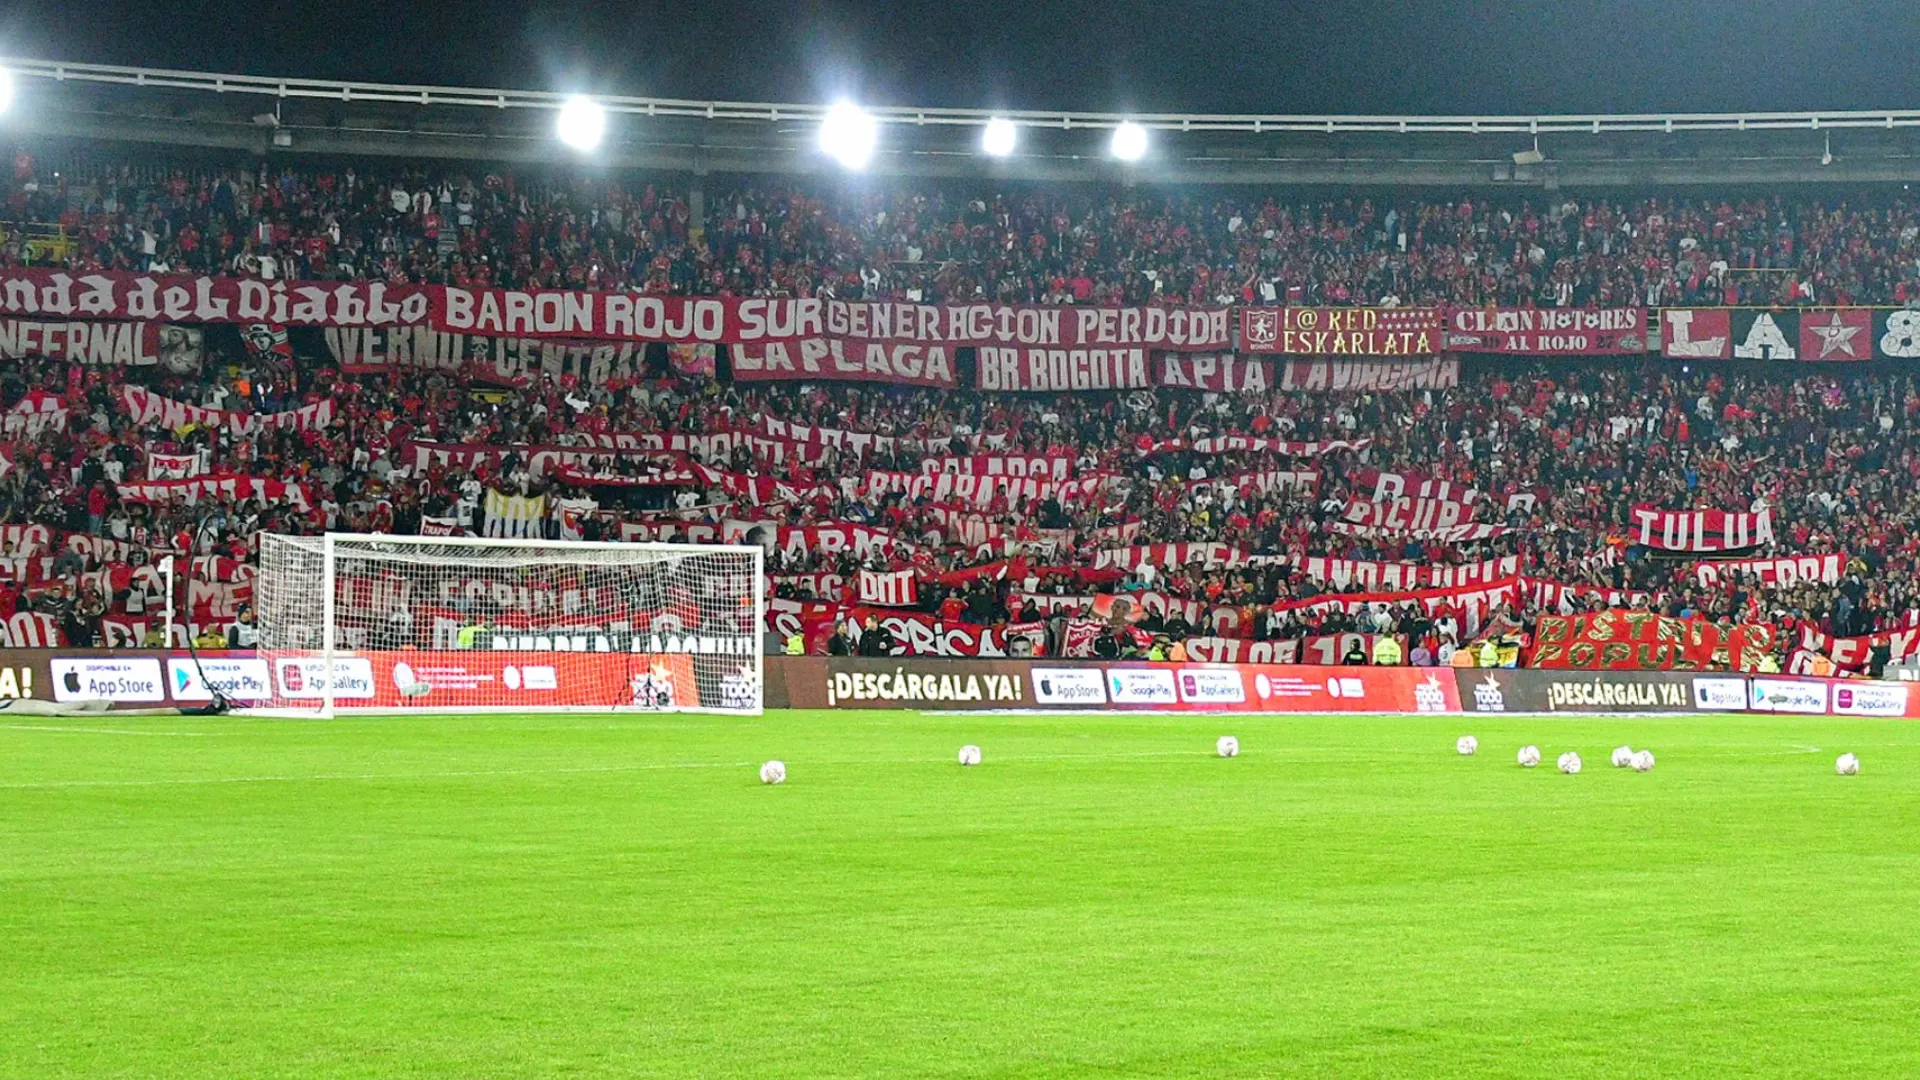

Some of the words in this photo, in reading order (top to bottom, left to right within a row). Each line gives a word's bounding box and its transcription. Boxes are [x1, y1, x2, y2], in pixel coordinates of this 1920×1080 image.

[446, 287, 593, 332] BARON
[605, 295, 723, 340] ROJO
[738, 298, 822, 339] SUR
[1328, 308, 1377, 331] RED
[1283, 331, 1431, 354] ESKARLATA
[1537, 336, 1588, 350] ROJO
[732, 342, 795, 371] LA
[800, 338, 952, 381] PLAGA
[1636, 509, 1774, 551] TULUA
[89, 678, 117, 697] App
[118, 677, 153, 693] Store
[242, 676, 263, 692] Play
[827, 667, 982, 706] ¡DESCÁRGALA
[983, 675, 1021, 700] YA!
[1547, 677, 1658, 711] ¡DESCÁRGALA
[1658, 683, 1687, 706] YA!
